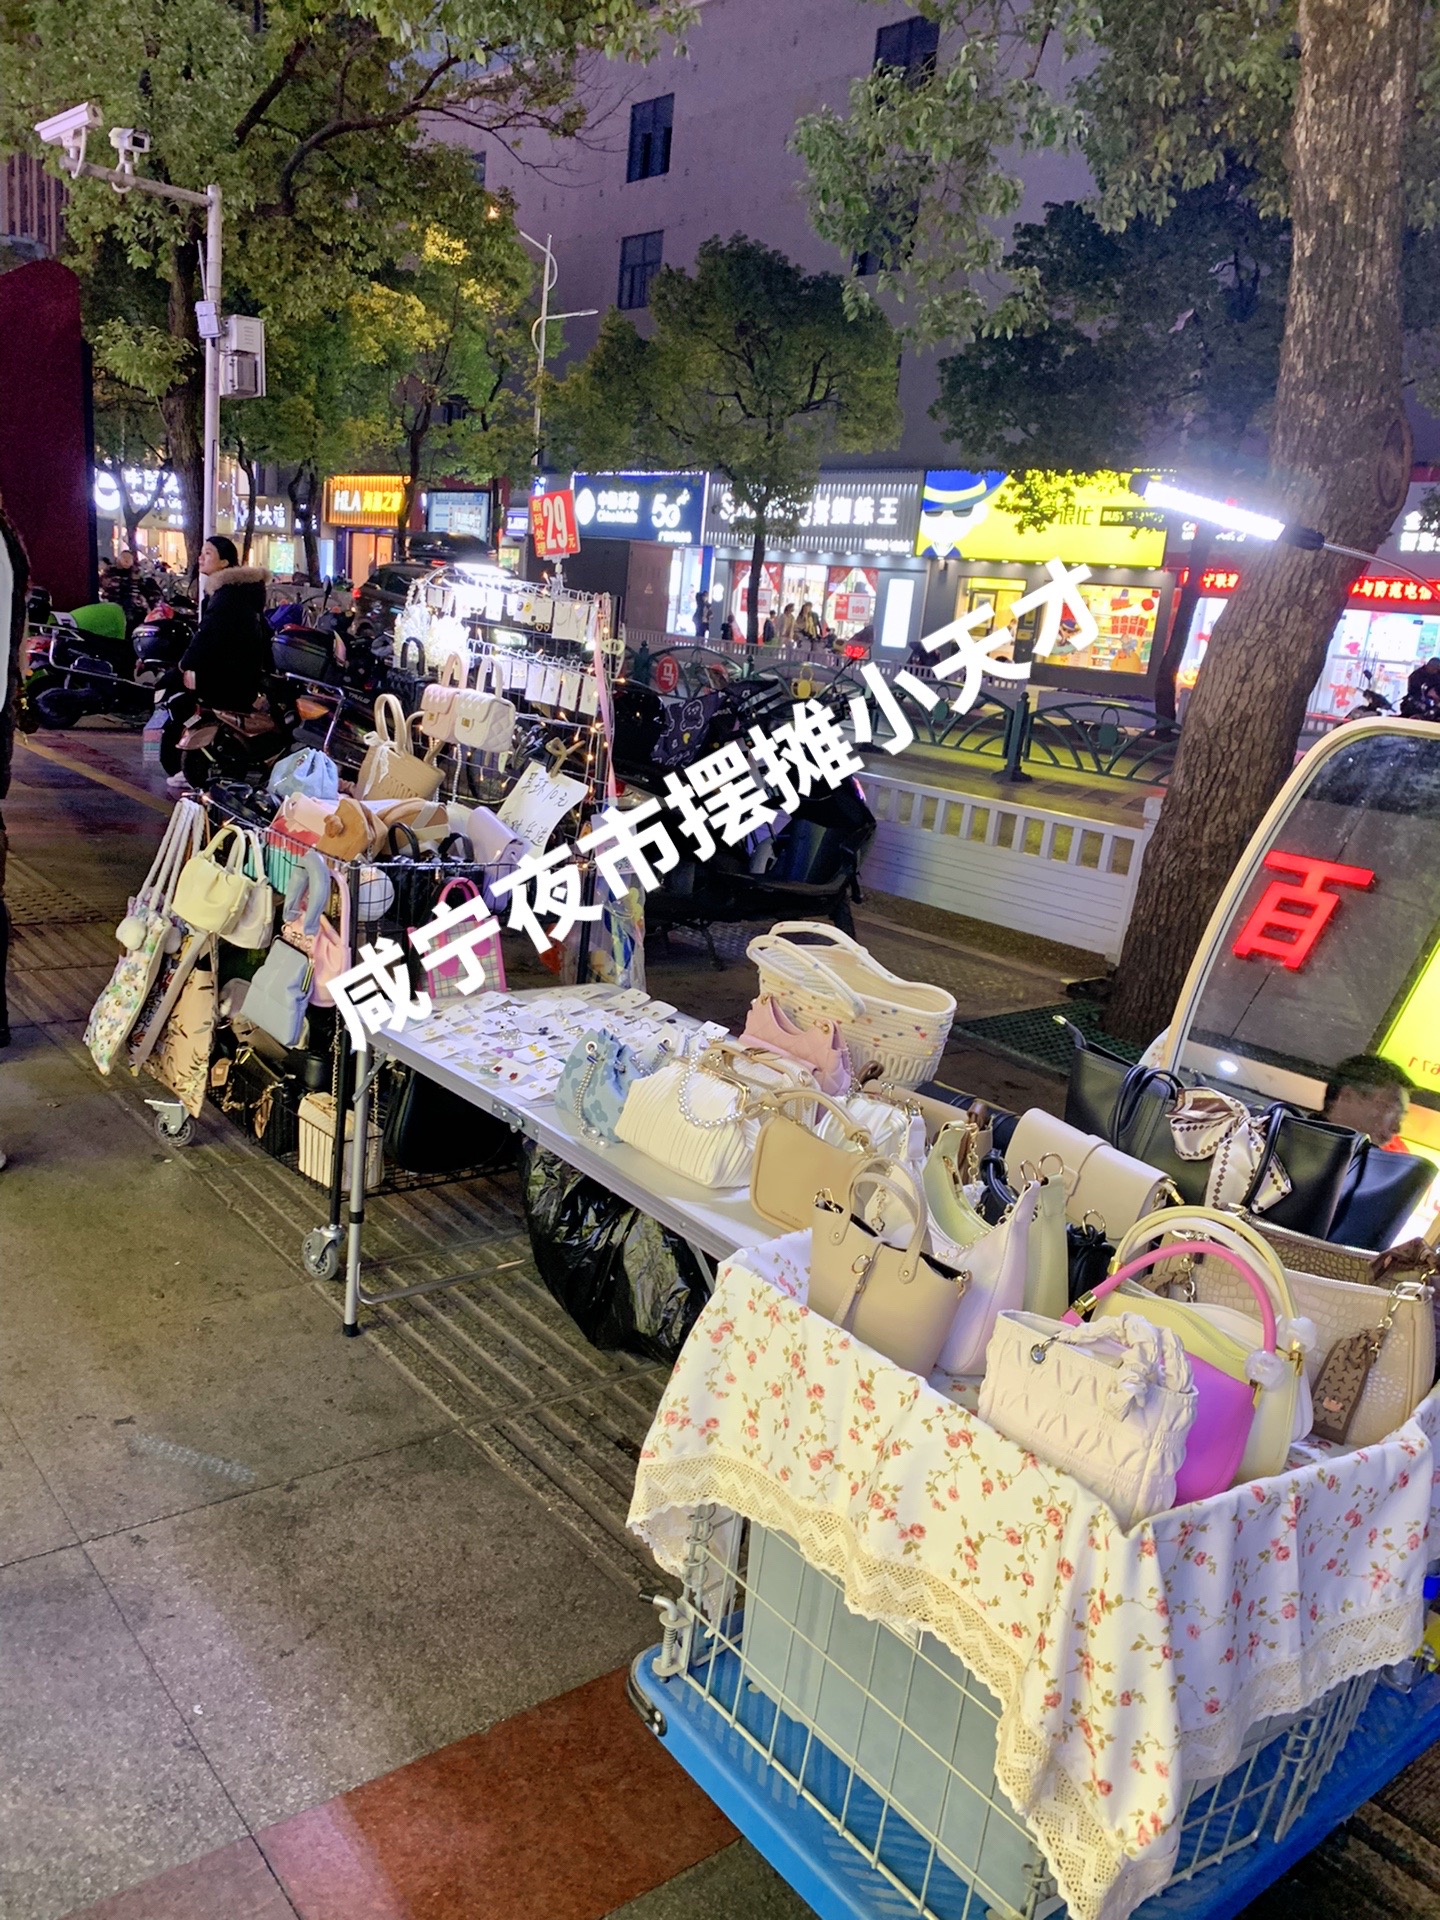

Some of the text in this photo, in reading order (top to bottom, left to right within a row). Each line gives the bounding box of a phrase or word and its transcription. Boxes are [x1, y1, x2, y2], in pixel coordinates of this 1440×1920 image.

[334, 490, 361, 513] HLA
[532, 499, 547, 555] 断码处理
[542, 495, 568, 550] 29
[567, 533, 577, 549] 元
[660, 662, 675, 687] 马
